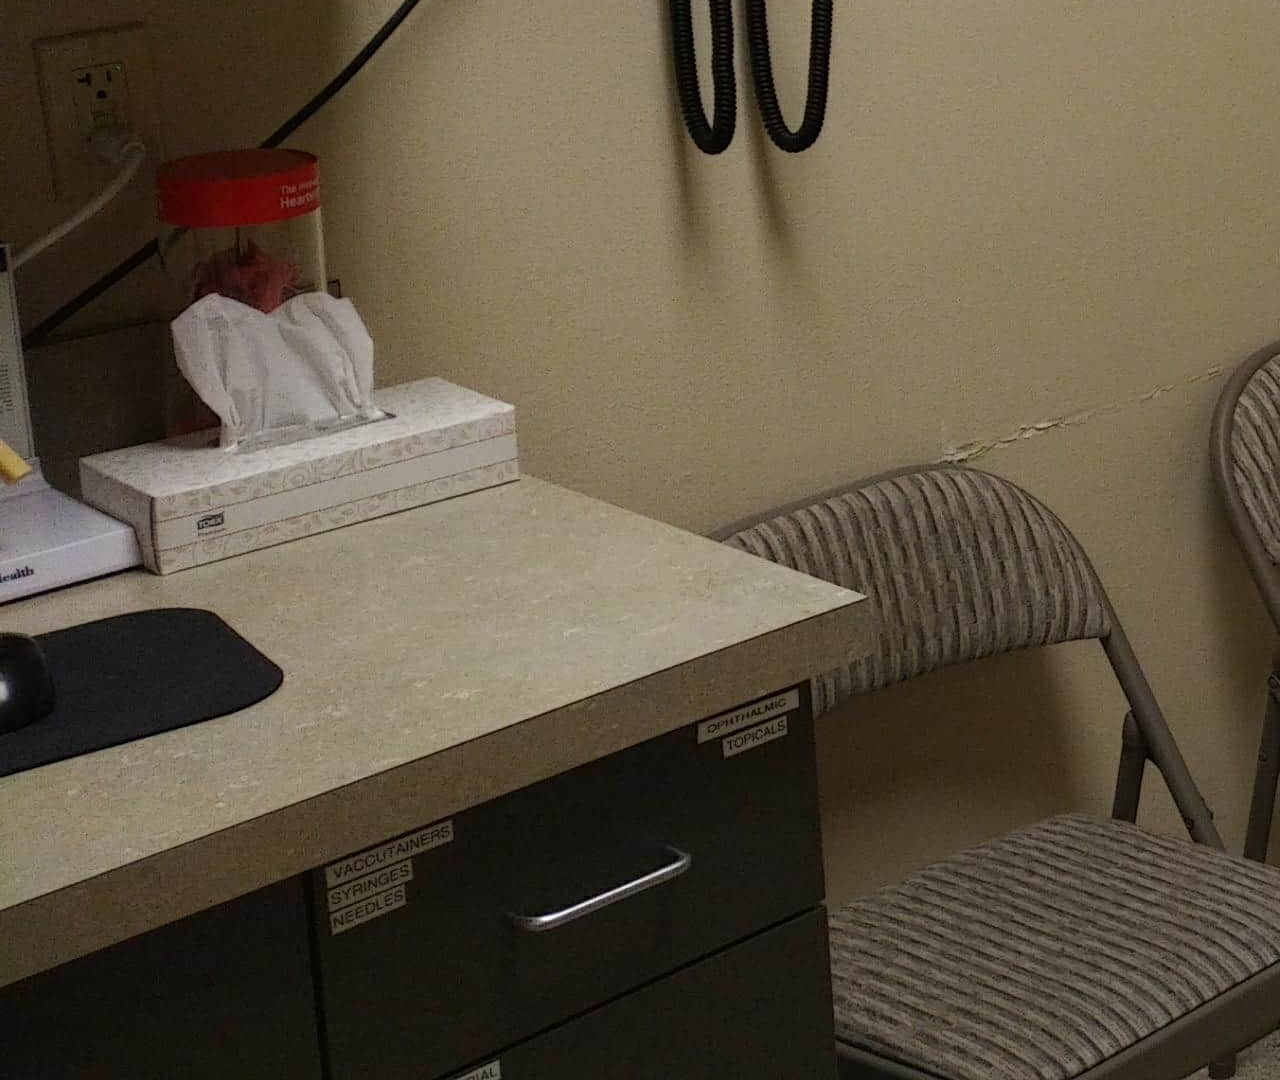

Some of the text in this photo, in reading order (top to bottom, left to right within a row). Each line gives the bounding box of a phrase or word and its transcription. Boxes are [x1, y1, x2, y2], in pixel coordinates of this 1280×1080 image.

[0, 565, 35, 584] ealth
[707, 697, 787, 734] OPHTHALMIC
[726, 720, 786, 750] TOPICALS
[331, 864, 410, 905] SYRINGES
[332, 890, 404, 929] NEEDLES
